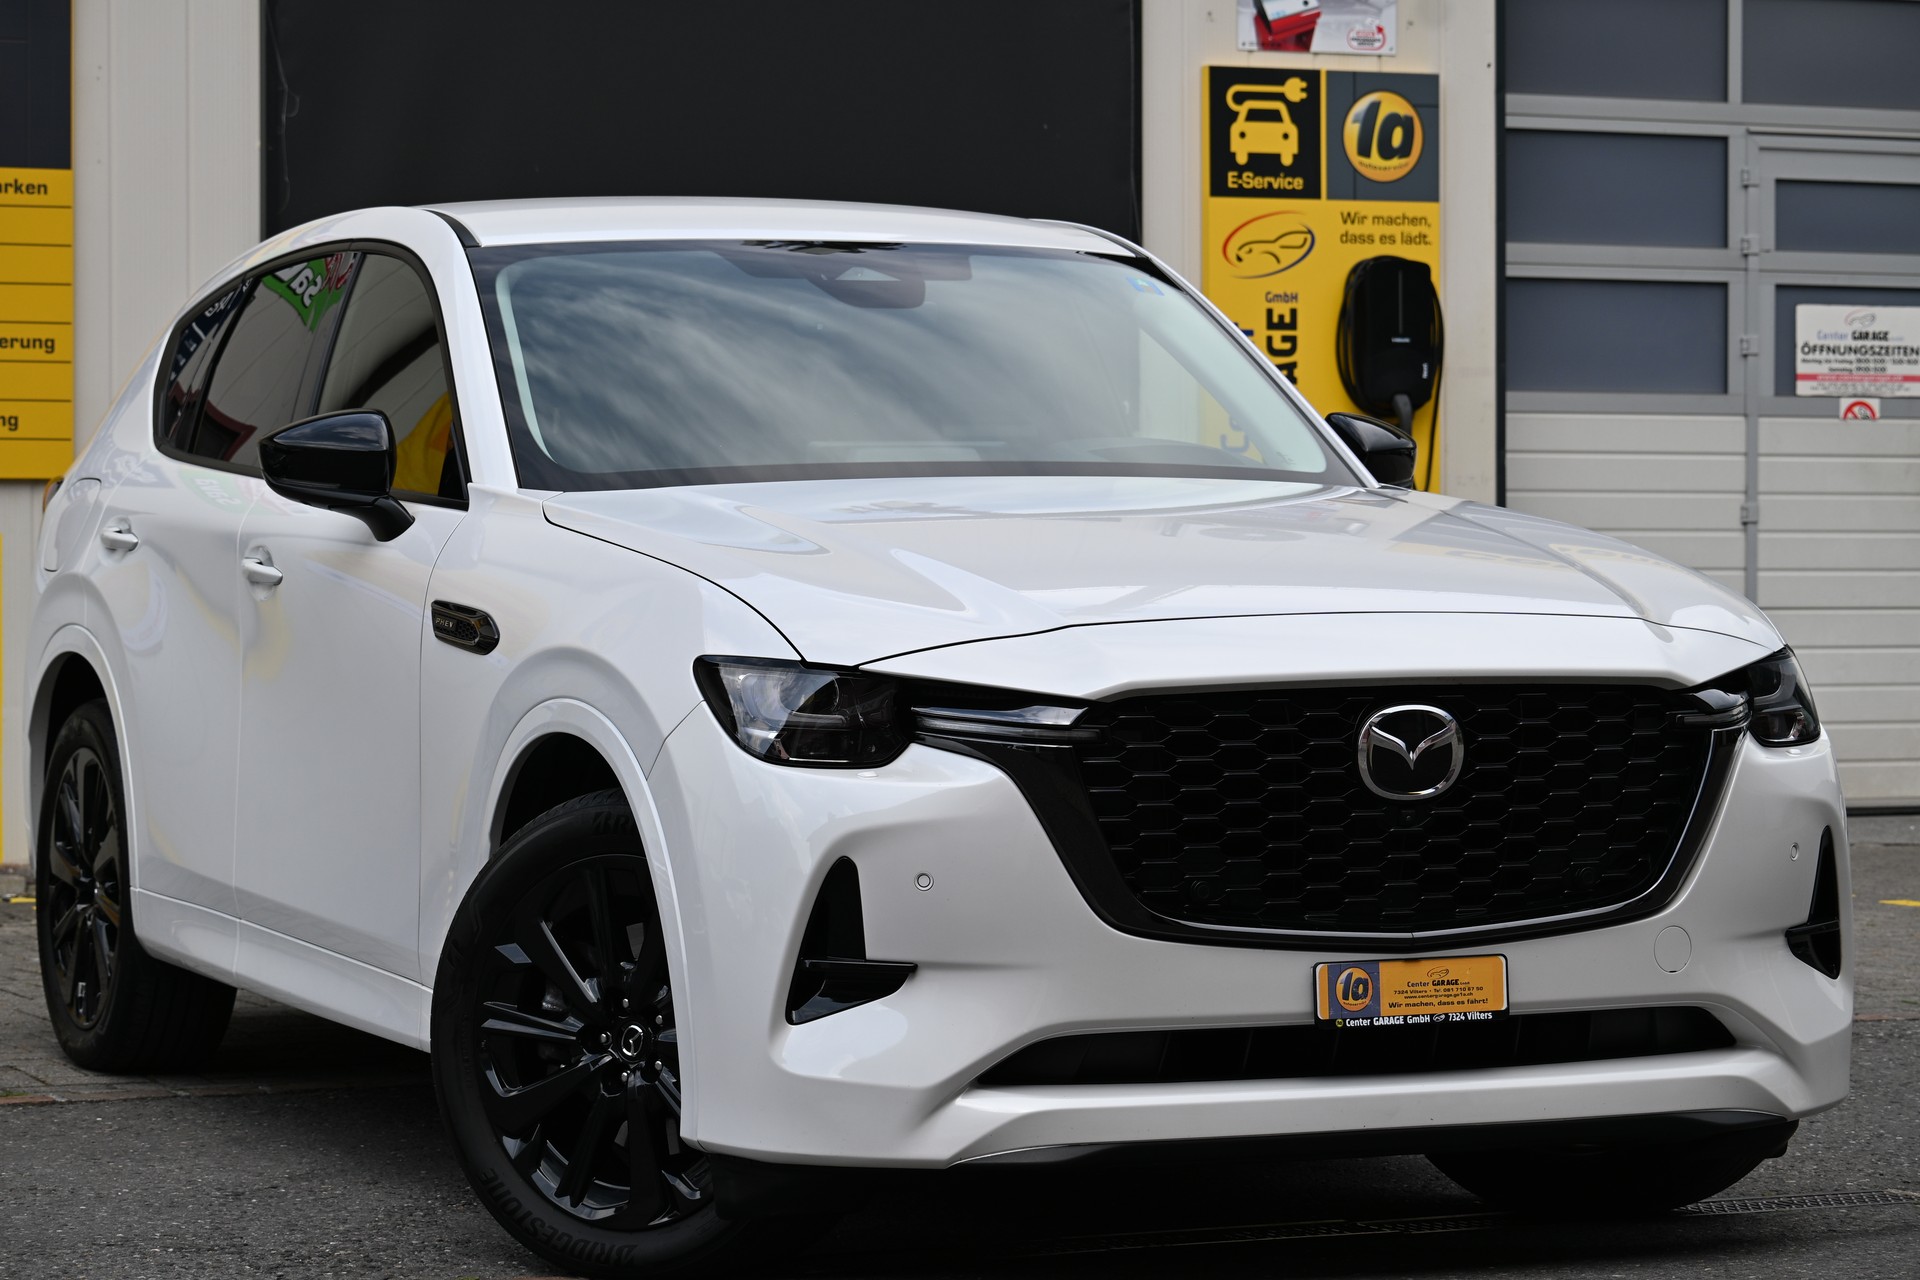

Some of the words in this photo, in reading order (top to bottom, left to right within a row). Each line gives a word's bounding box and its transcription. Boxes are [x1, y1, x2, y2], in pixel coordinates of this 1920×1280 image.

[1352, 100, 1414, 161] 1a
[1227, 171, 1304, 190] E-Service
[1340, 211, 1367, 225] Wir
[1372, 213, 1431, 228] machen,
[1340, 231, 1375, 245] dass
[1379, 233, 1396, 245] es
[1400, 231, 1432, 246] lädt.
[1265, 291, 1298, 304] GmbH
[1851, 330, 1889, 341] GARAGE
[1801, 342, 1920, 356] ÖFFNUNGSZEITEN
[1339, 972, 1369, 1001] 1a
[1346, 1018, 1371, 1027] Center
[1373, 1015, 1404, 1026] GARAGE
[1407, 1014, 1430, 1023] GmbH
[1448, 1012, 1465, 1021] 7324
[1466, 1010, 1492, 1020] Vilters
